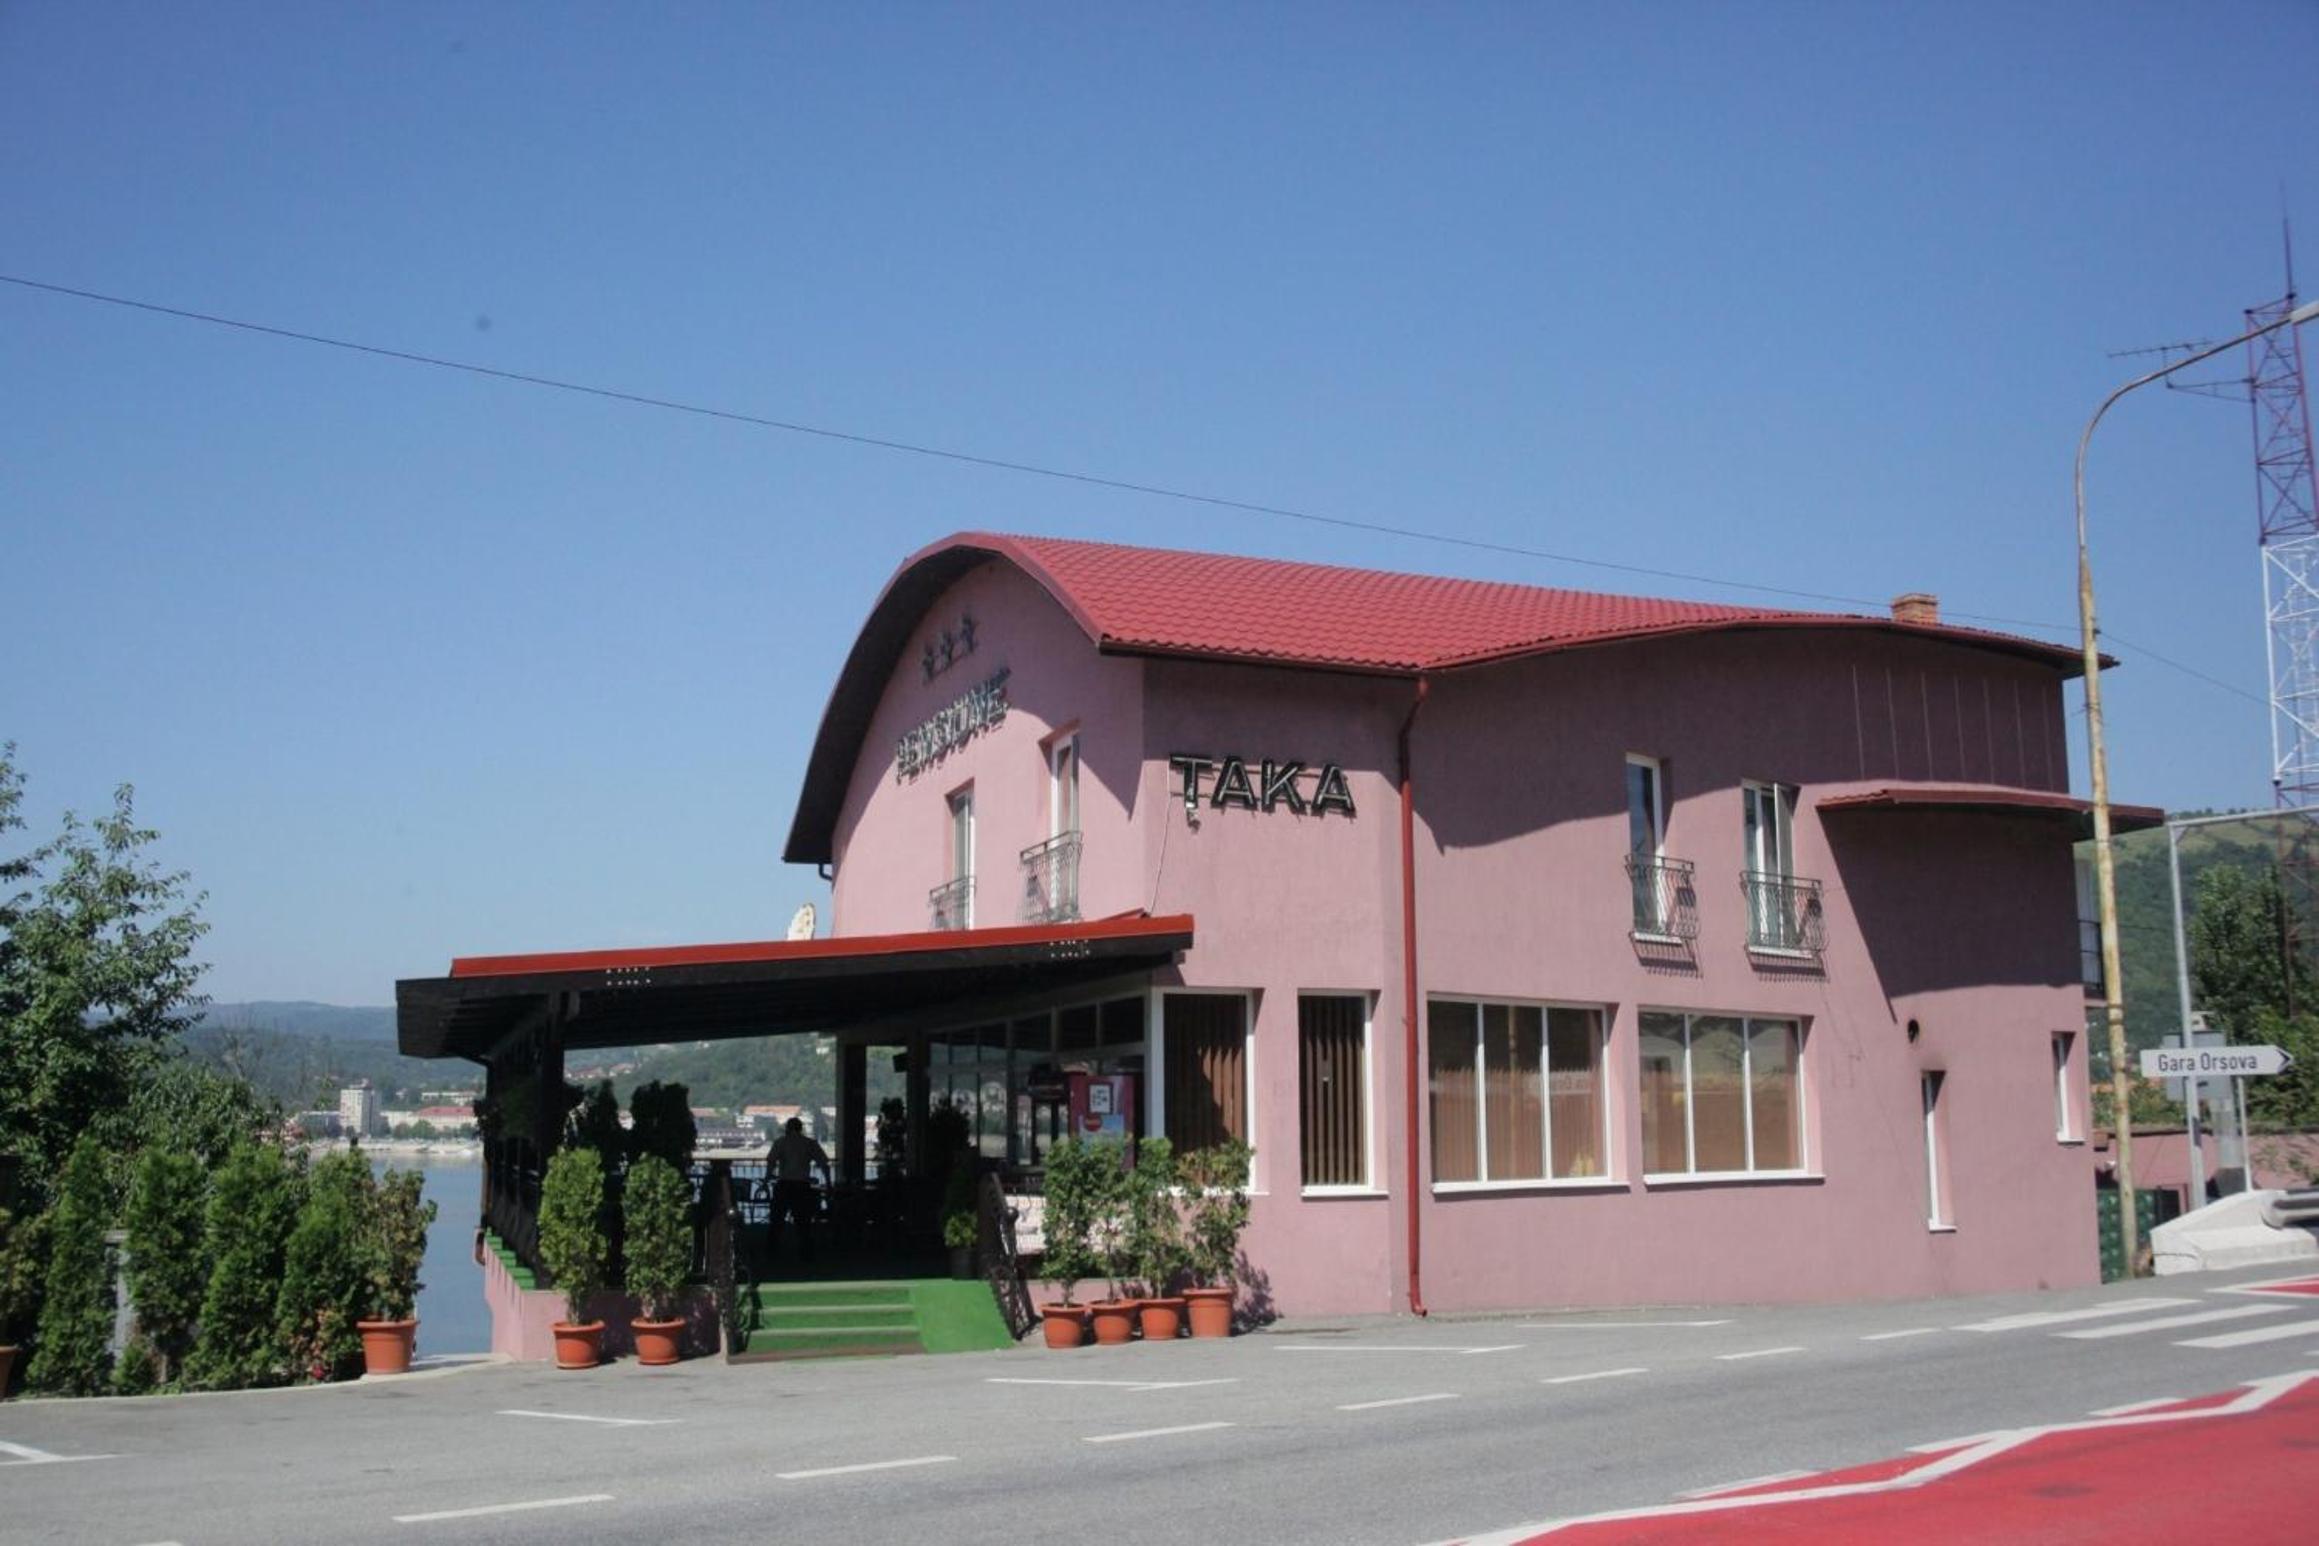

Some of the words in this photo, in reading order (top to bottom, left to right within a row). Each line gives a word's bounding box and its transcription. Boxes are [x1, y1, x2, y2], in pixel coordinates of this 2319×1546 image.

[1169, 754, 1356, 820] TAKA
[2158, 1054, 2196, 1072] Gara
[2200, 1053, 2258, 1070] Orsova
